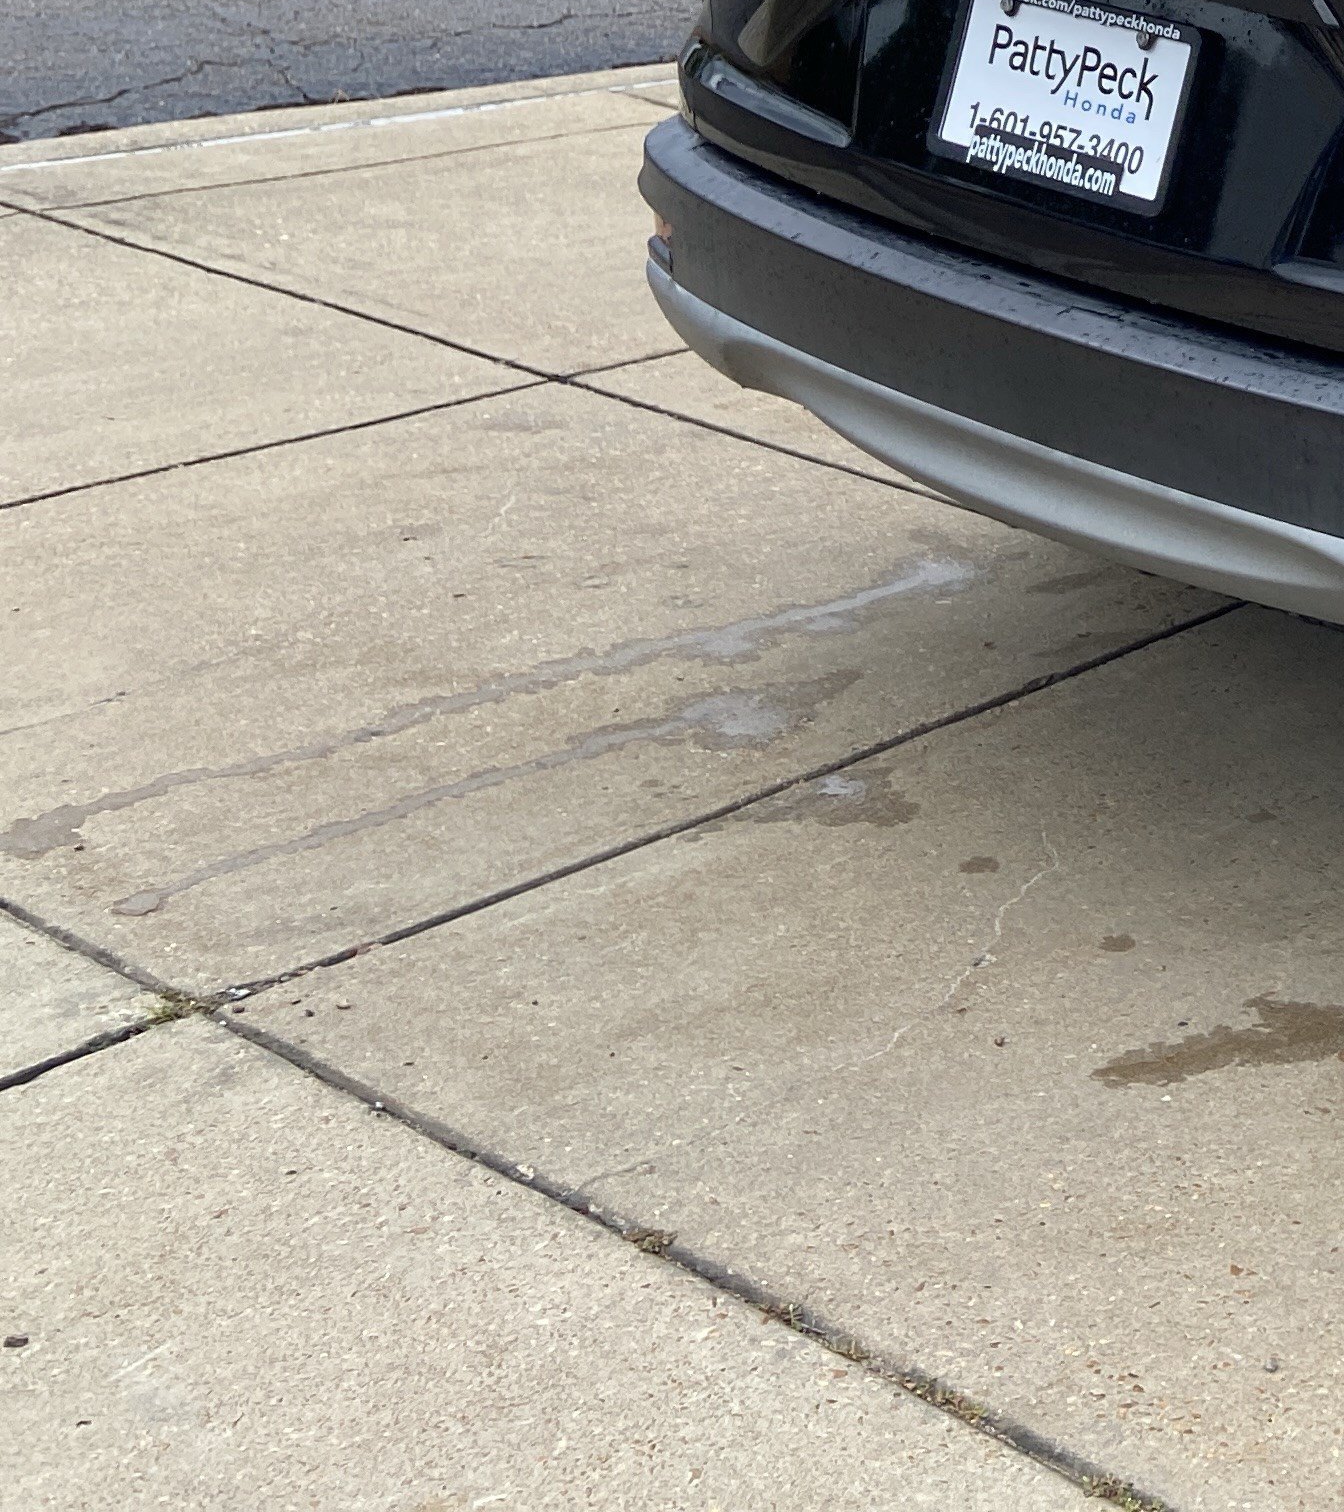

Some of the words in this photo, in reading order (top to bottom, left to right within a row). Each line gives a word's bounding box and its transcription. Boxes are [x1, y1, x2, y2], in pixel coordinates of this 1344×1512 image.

[988, 23, 1159, 121] PattyPeck
[968, 101, 1143, 175] 1-601-957-3400
[1063, 90, 1136, 124] Honda
[966, 133, 1116, 196] pattypeckhonda.com
